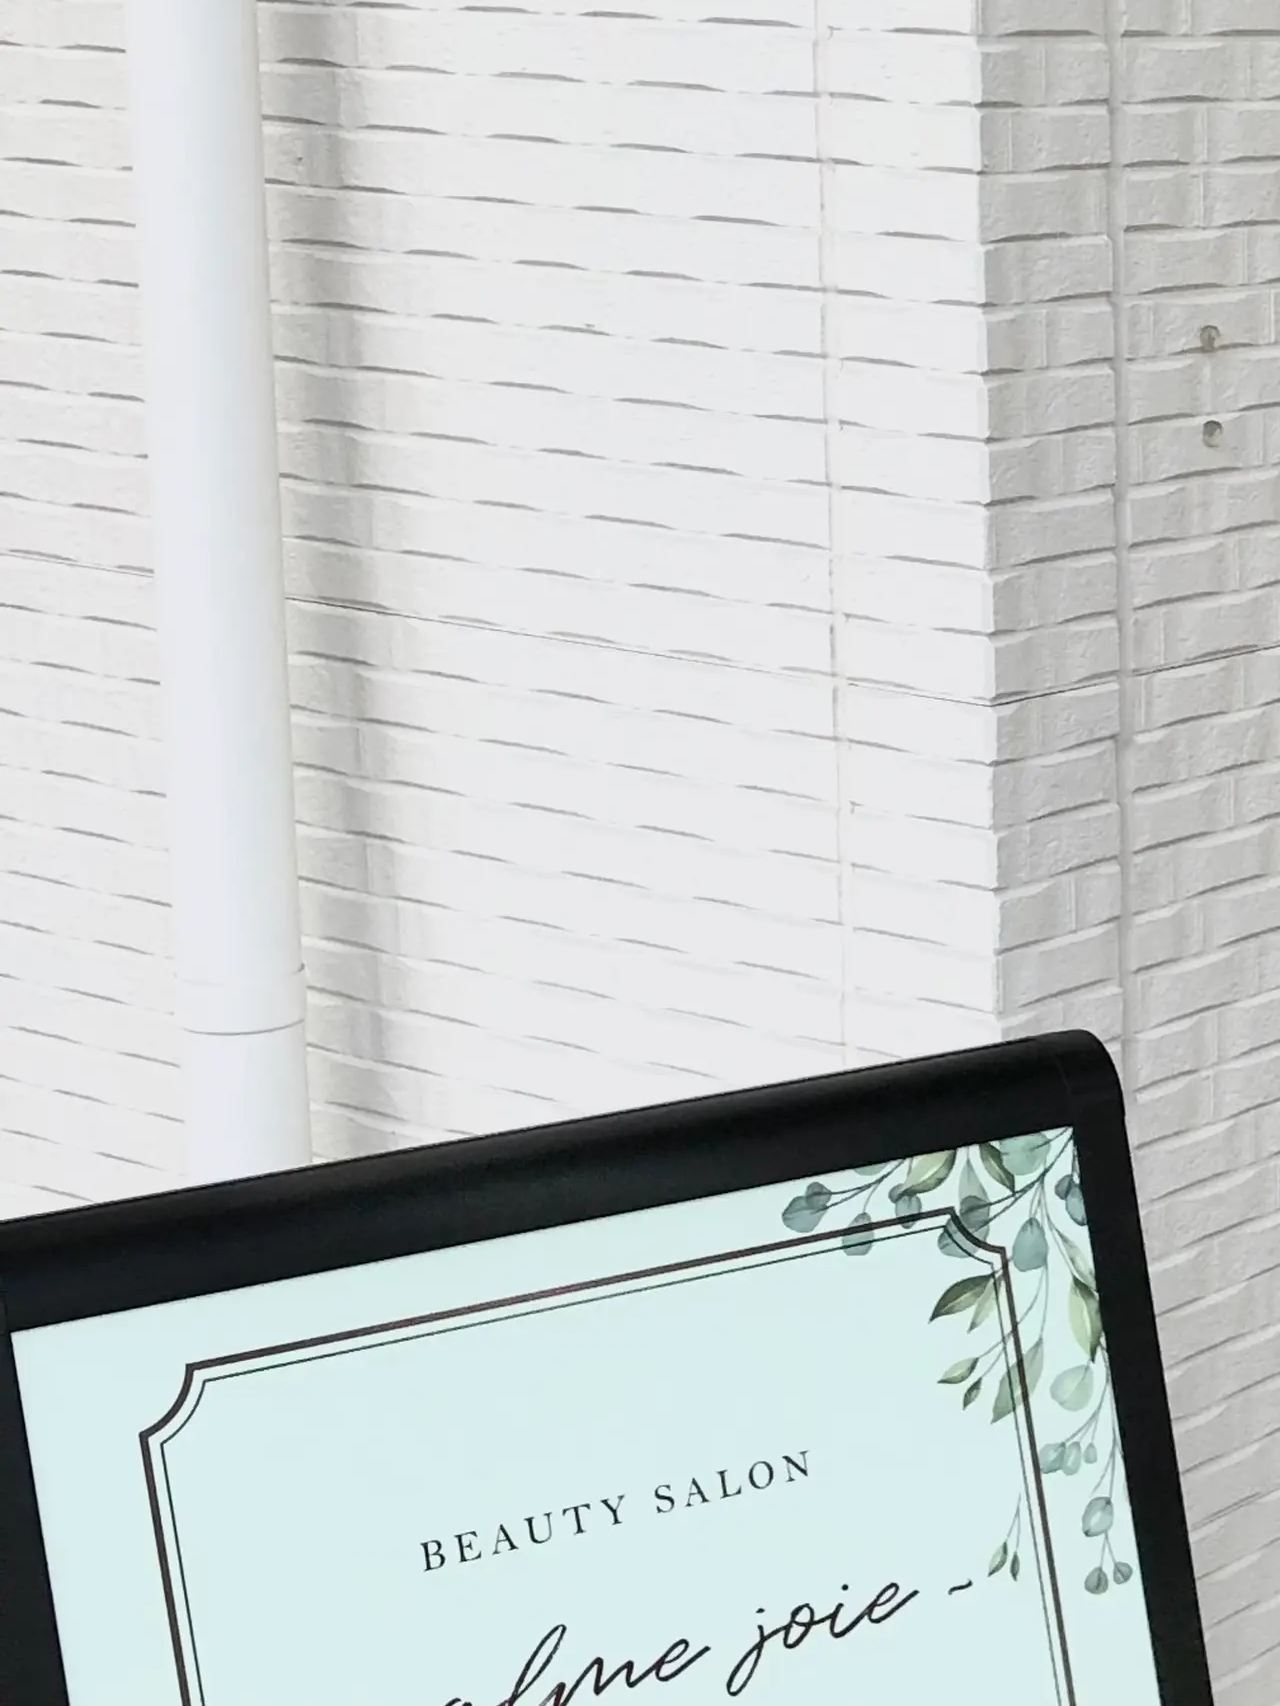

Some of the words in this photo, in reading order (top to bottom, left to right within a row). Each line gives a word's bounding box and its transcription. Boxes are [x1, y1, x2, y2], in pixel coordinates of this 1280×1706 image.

[419, 1493, 626, 1573] BEAUTY
[653, 1449, 810, 1515] SALON
[724, 1581, 921, 1698] joie
